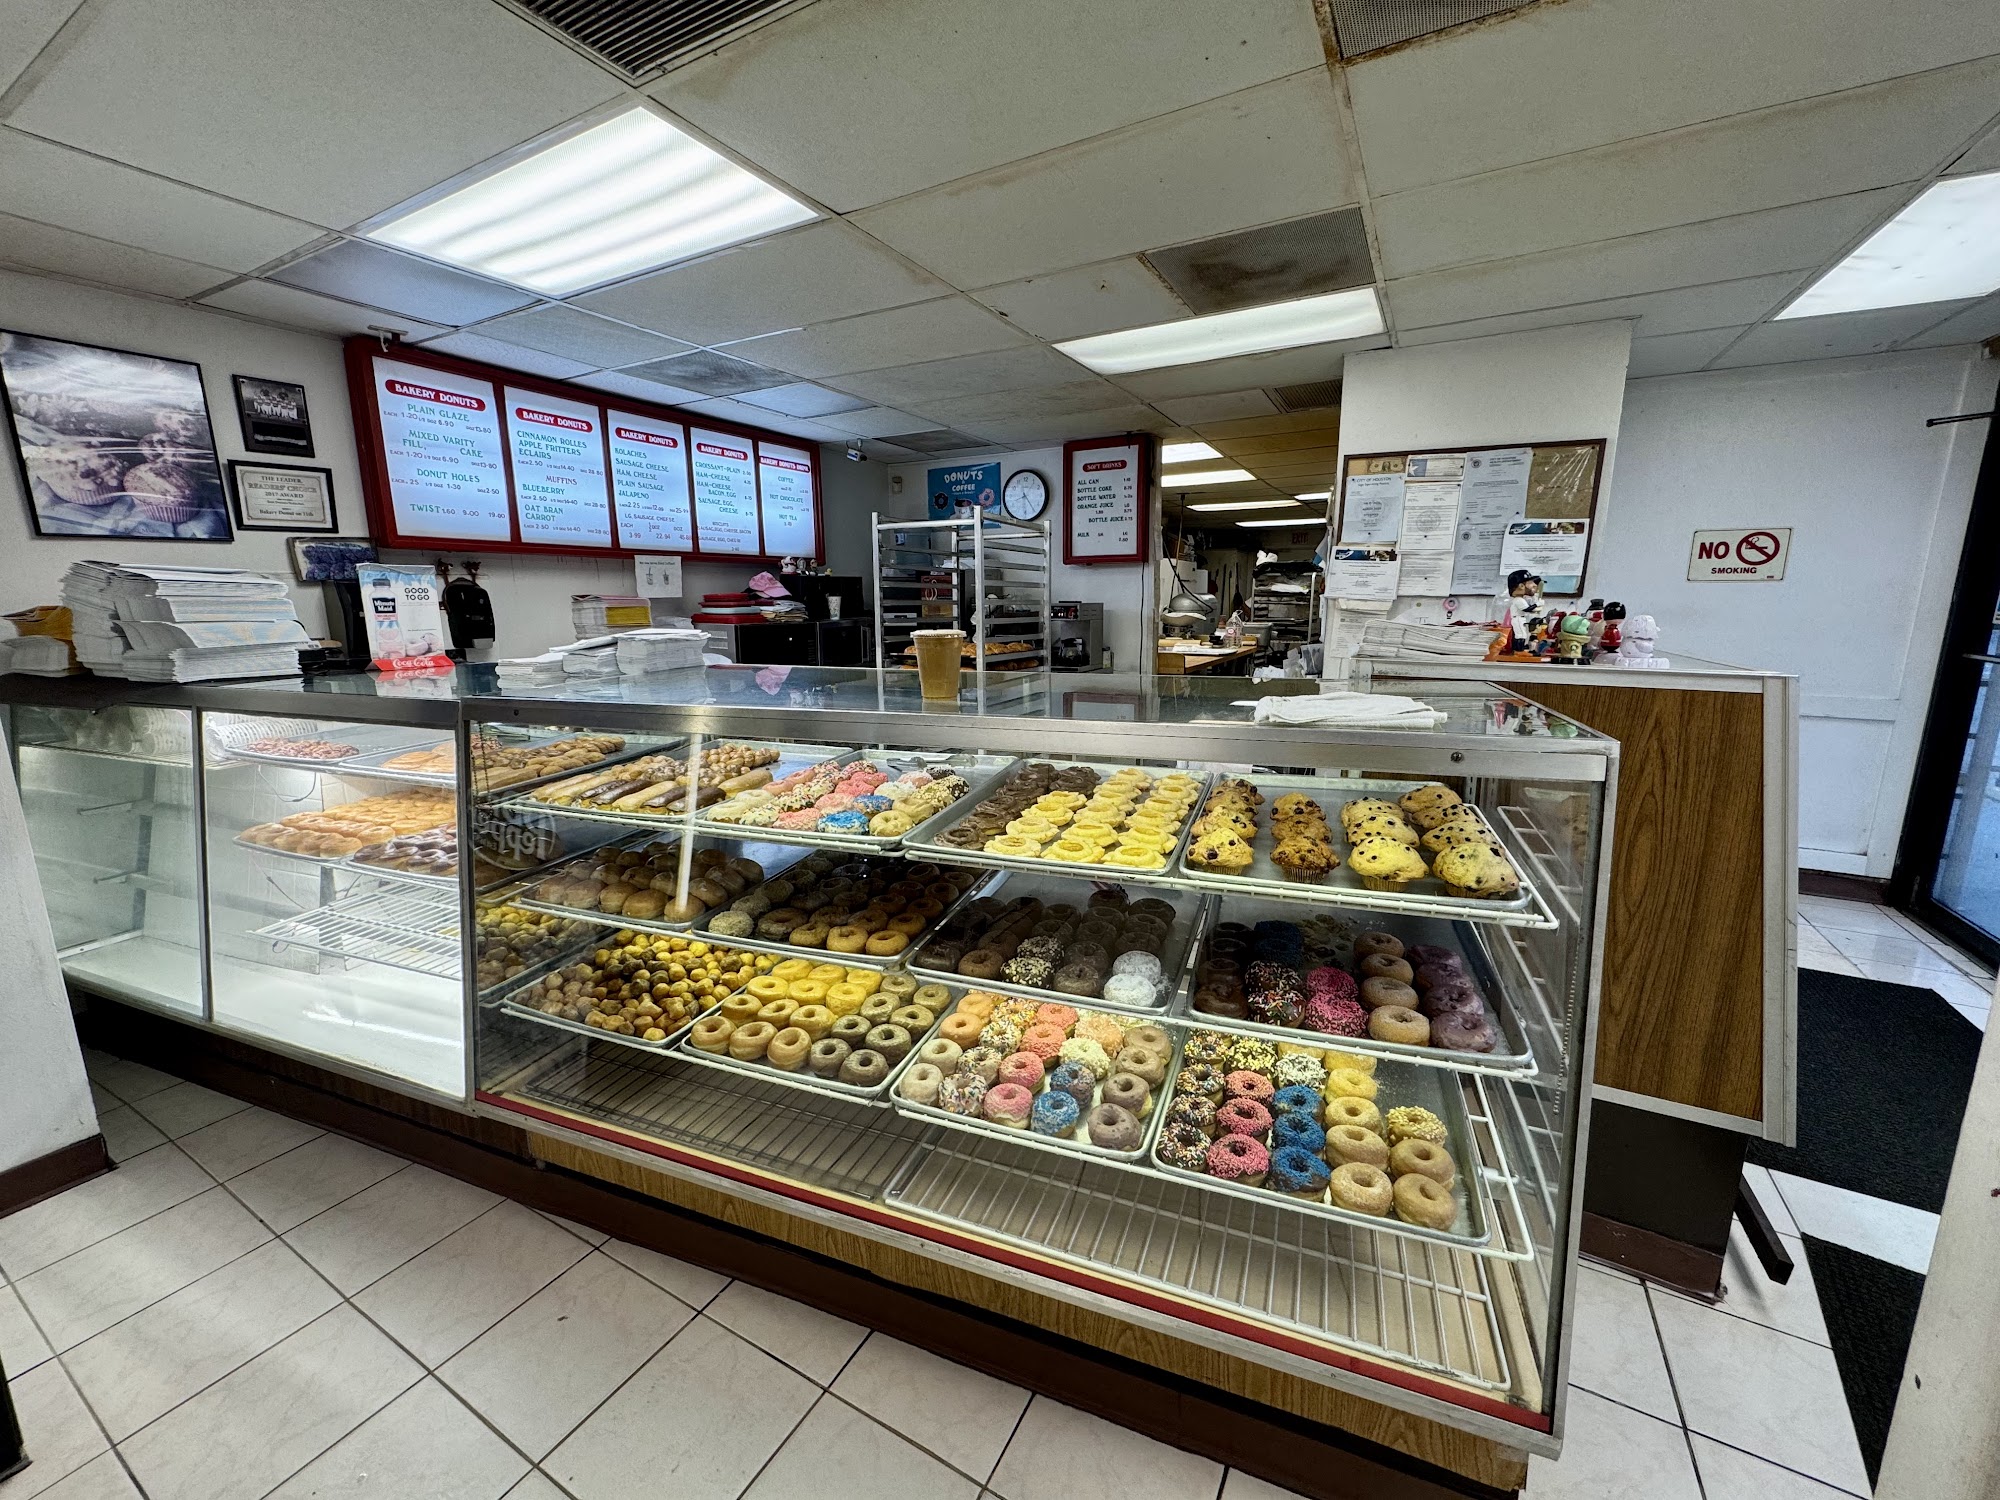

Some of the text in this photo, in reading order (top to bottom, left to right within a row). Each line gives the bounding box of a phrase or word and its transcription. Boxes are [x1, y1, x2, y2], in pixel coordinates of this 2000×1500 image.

[395, 383, 478, 408] BAKERY DONUTS
[407, 403, 470, 422] PLAIN GLAZE
[522, 410, 588, 430] BAKERY DONUTS
[408, 429, 475, 448] MIXED VARITY
[517, 430, 587, 449] CINNAMON ROLLES
[620, 429, 674, 447] BAKERY DONUTS
[459, 447, 483, 458] CAKE
[518, 447, 552, 460] ECLAIRS
[519, 440, 581, 456] APPLE FRITTERS
[614, 447, 647, 459] KOLACHES
[700, 444, 745, 459] BAKERY DONUTS
[615, 457, 669, 473] SAUSAGE CHEESE
[276, 476, 304, 484] LEADER
[416, 468, 481, 483] DONUT HOLES
[545, 474, 577, 486] MUFFINS
[633, 471, 657, 480] CHEESE
[943, 470, 983, 484] DONUTS
[287, 485, 318, 494] CHOICE
[522, 483, 565, 496] BLUEBERRY
[617, 479, 664, 492] PLAIN SAUSAGE
[951, 483, 976, 492] COFFEE
[618, 489, 649, 500] JALAPENO
[1077, 494, 1097, 502] BOTTLE
[409, 503, 441, 514] TWIST
[524, 504, 564, 515] OAT BRAN
[1077, 502, 1098, 510] ORANGE
[525, 512, 556, 522] CARROT
[633, 513, 655, 521] SAUSAGE
[1697, 541, 1730, 560] NO
[1711, 566, 1758, 575] SMOKING
